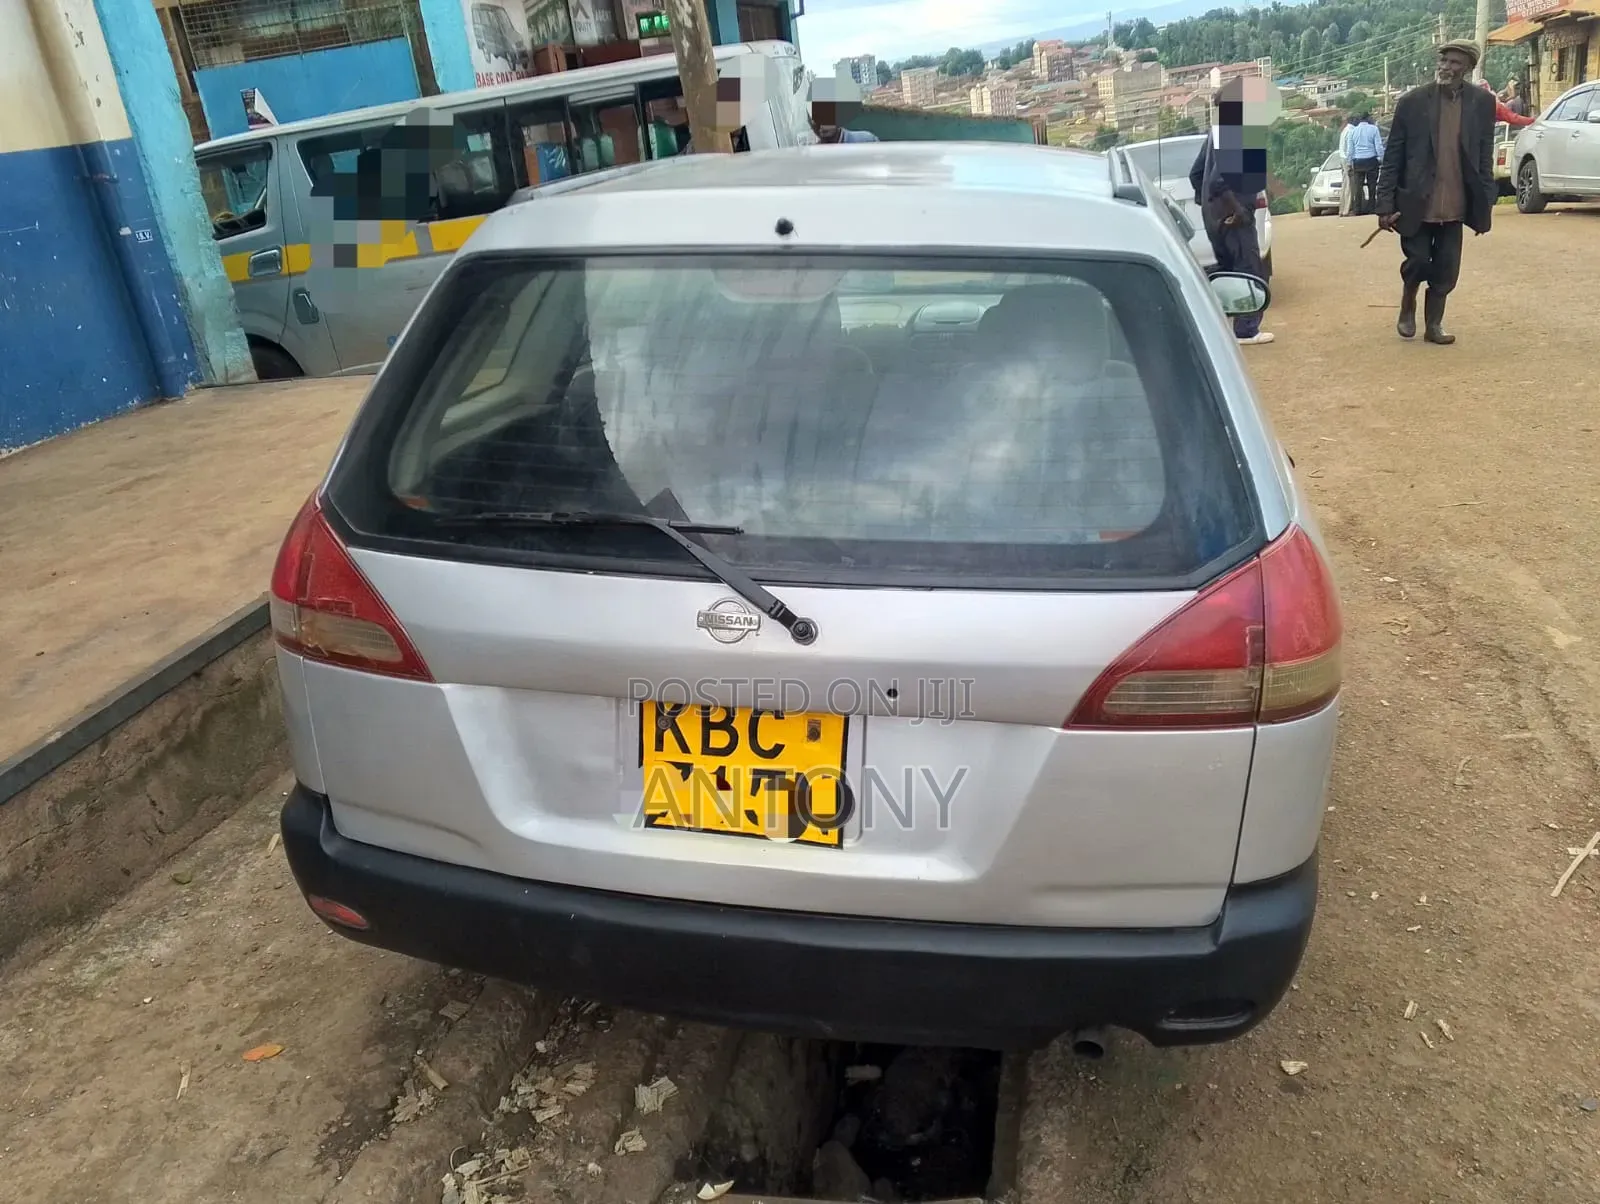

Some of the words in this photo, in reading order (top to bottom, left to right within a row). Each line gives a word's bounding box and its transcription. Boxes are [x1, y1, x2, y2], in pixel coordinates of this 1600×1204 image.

[475, 71, 495, 89] BASE
[495, 71, 513, 84] COAT
[703, 613, 754, 627] NISSAN
[654, 701, 786, 760] KBC
